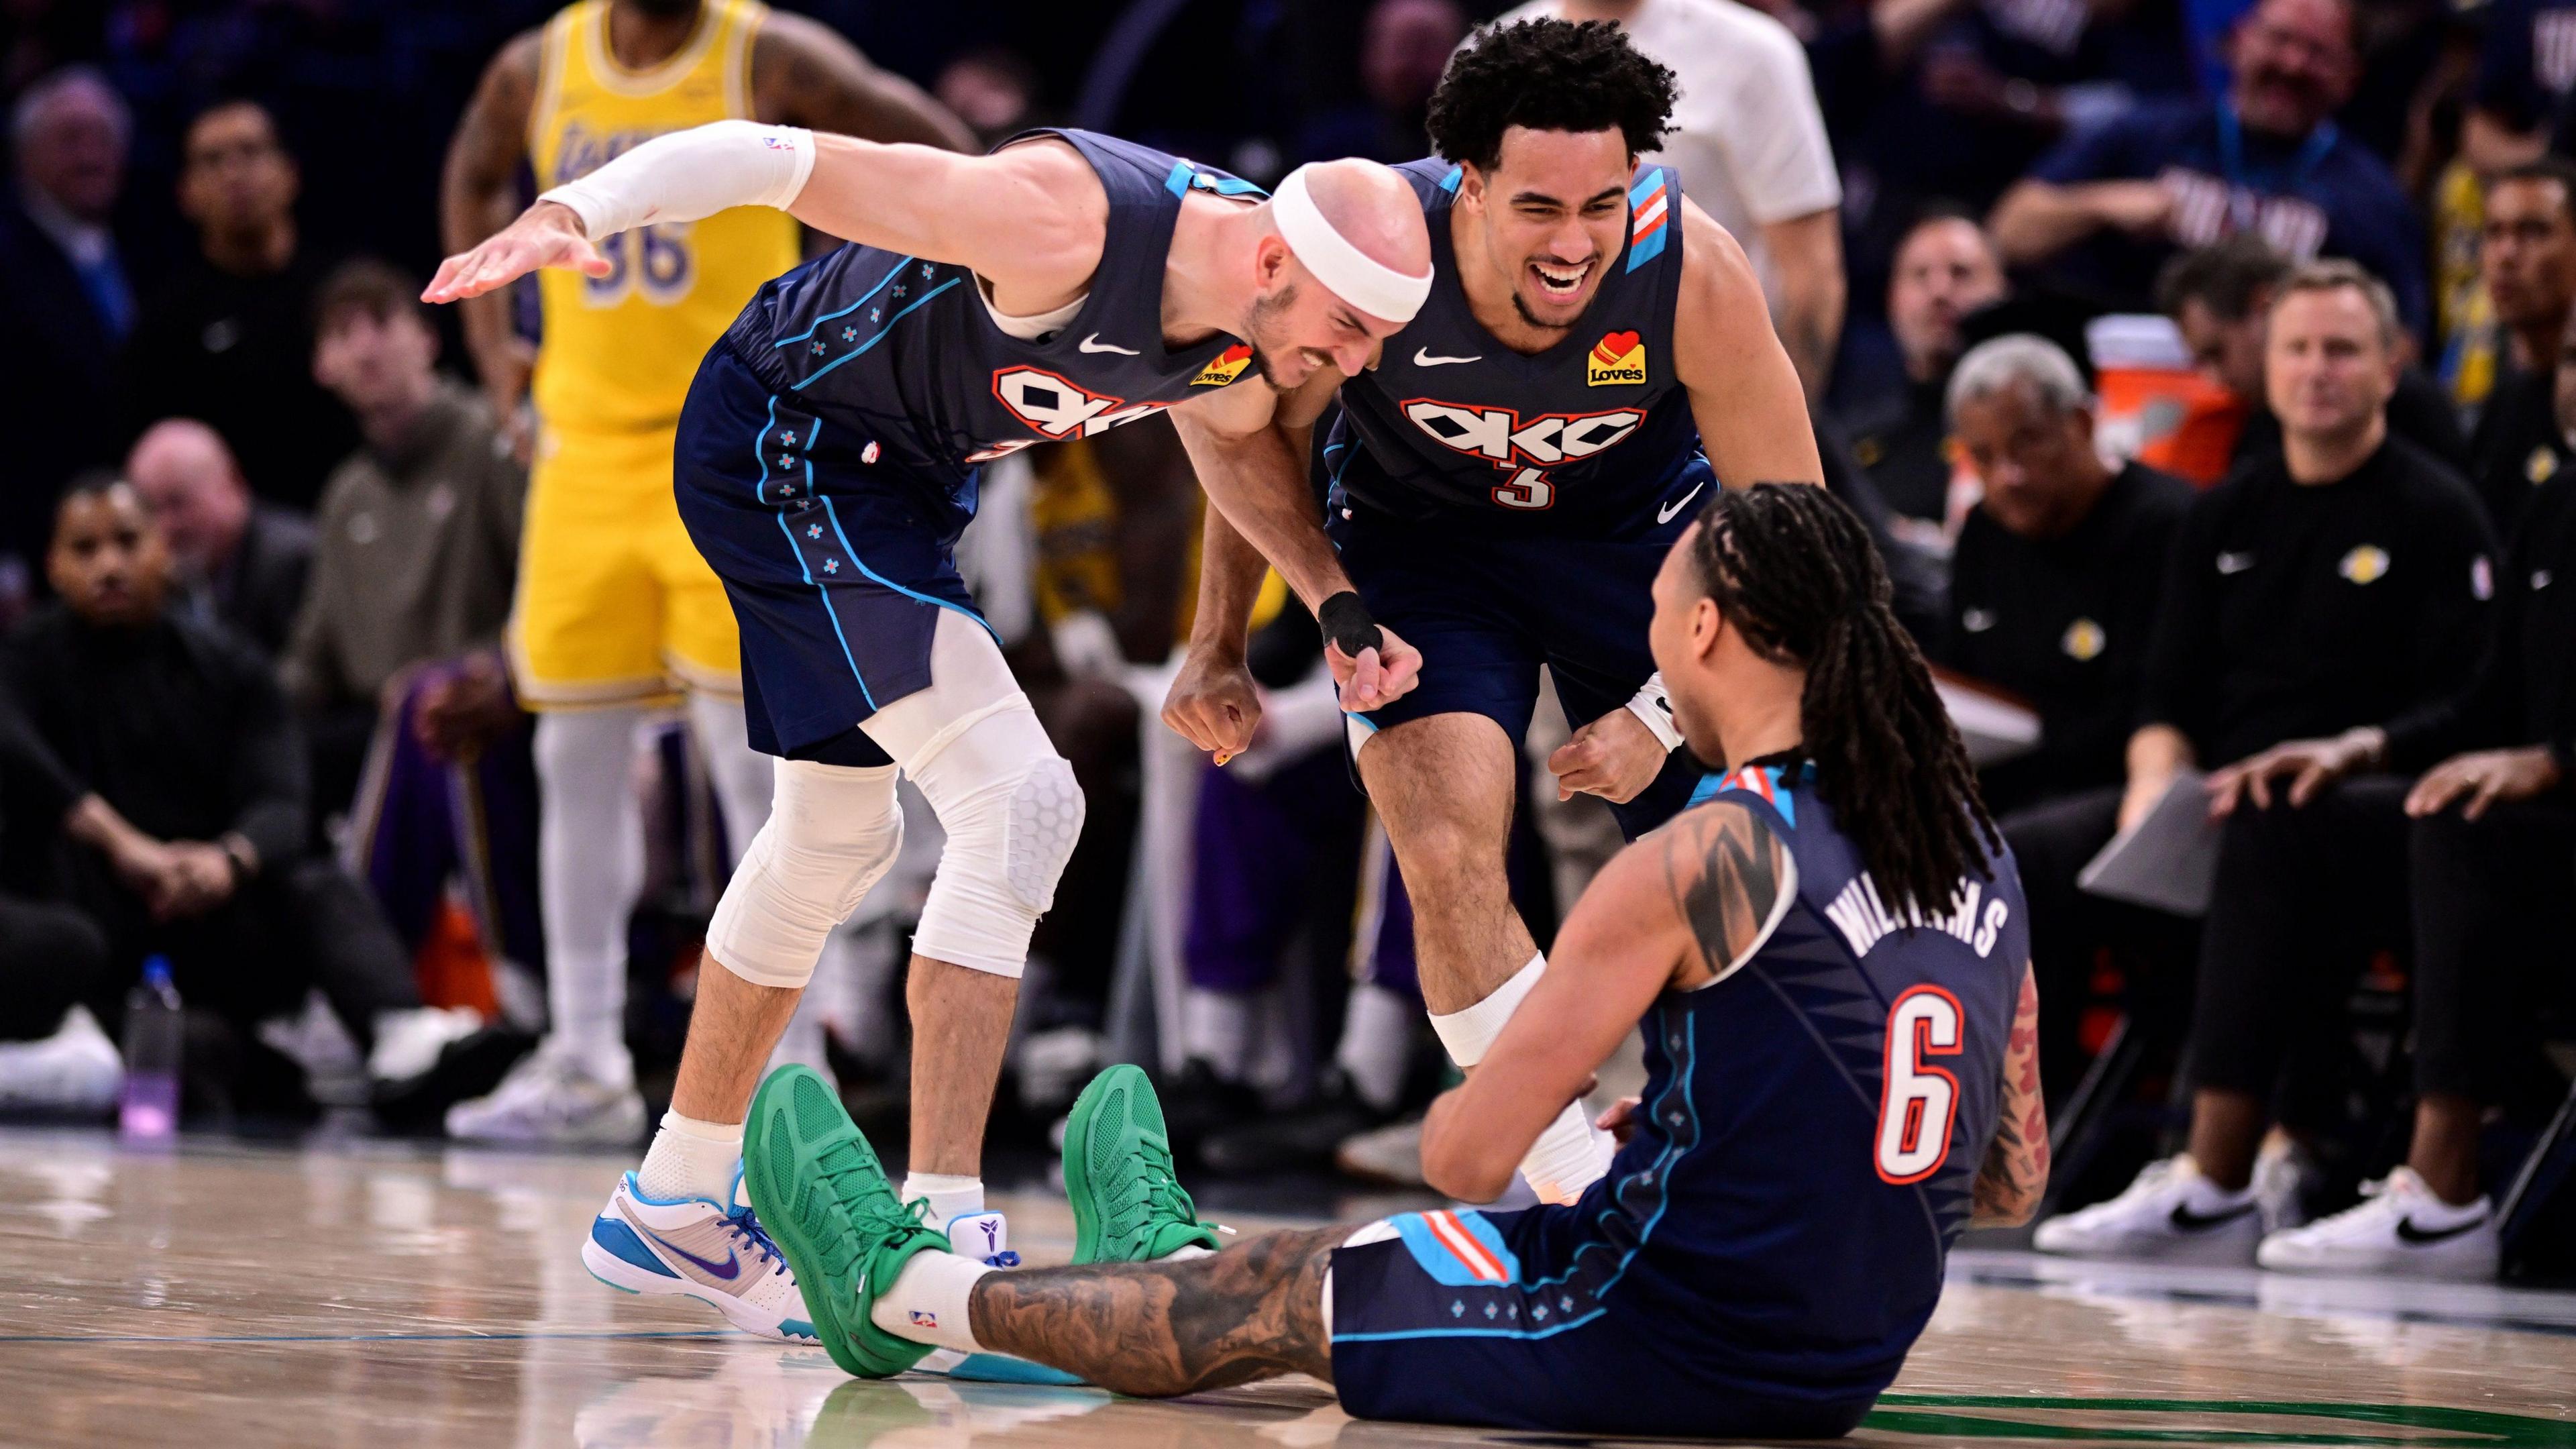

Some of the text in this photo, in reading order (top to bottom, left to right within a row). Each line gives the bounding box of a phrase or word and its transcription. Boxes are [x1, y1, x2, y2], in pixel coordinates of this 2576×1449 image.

[1399, 398, 1648, 466] OKC
[1491, 463, 1556, 510] 3
[1874, 983, 1966, 1185] 6
